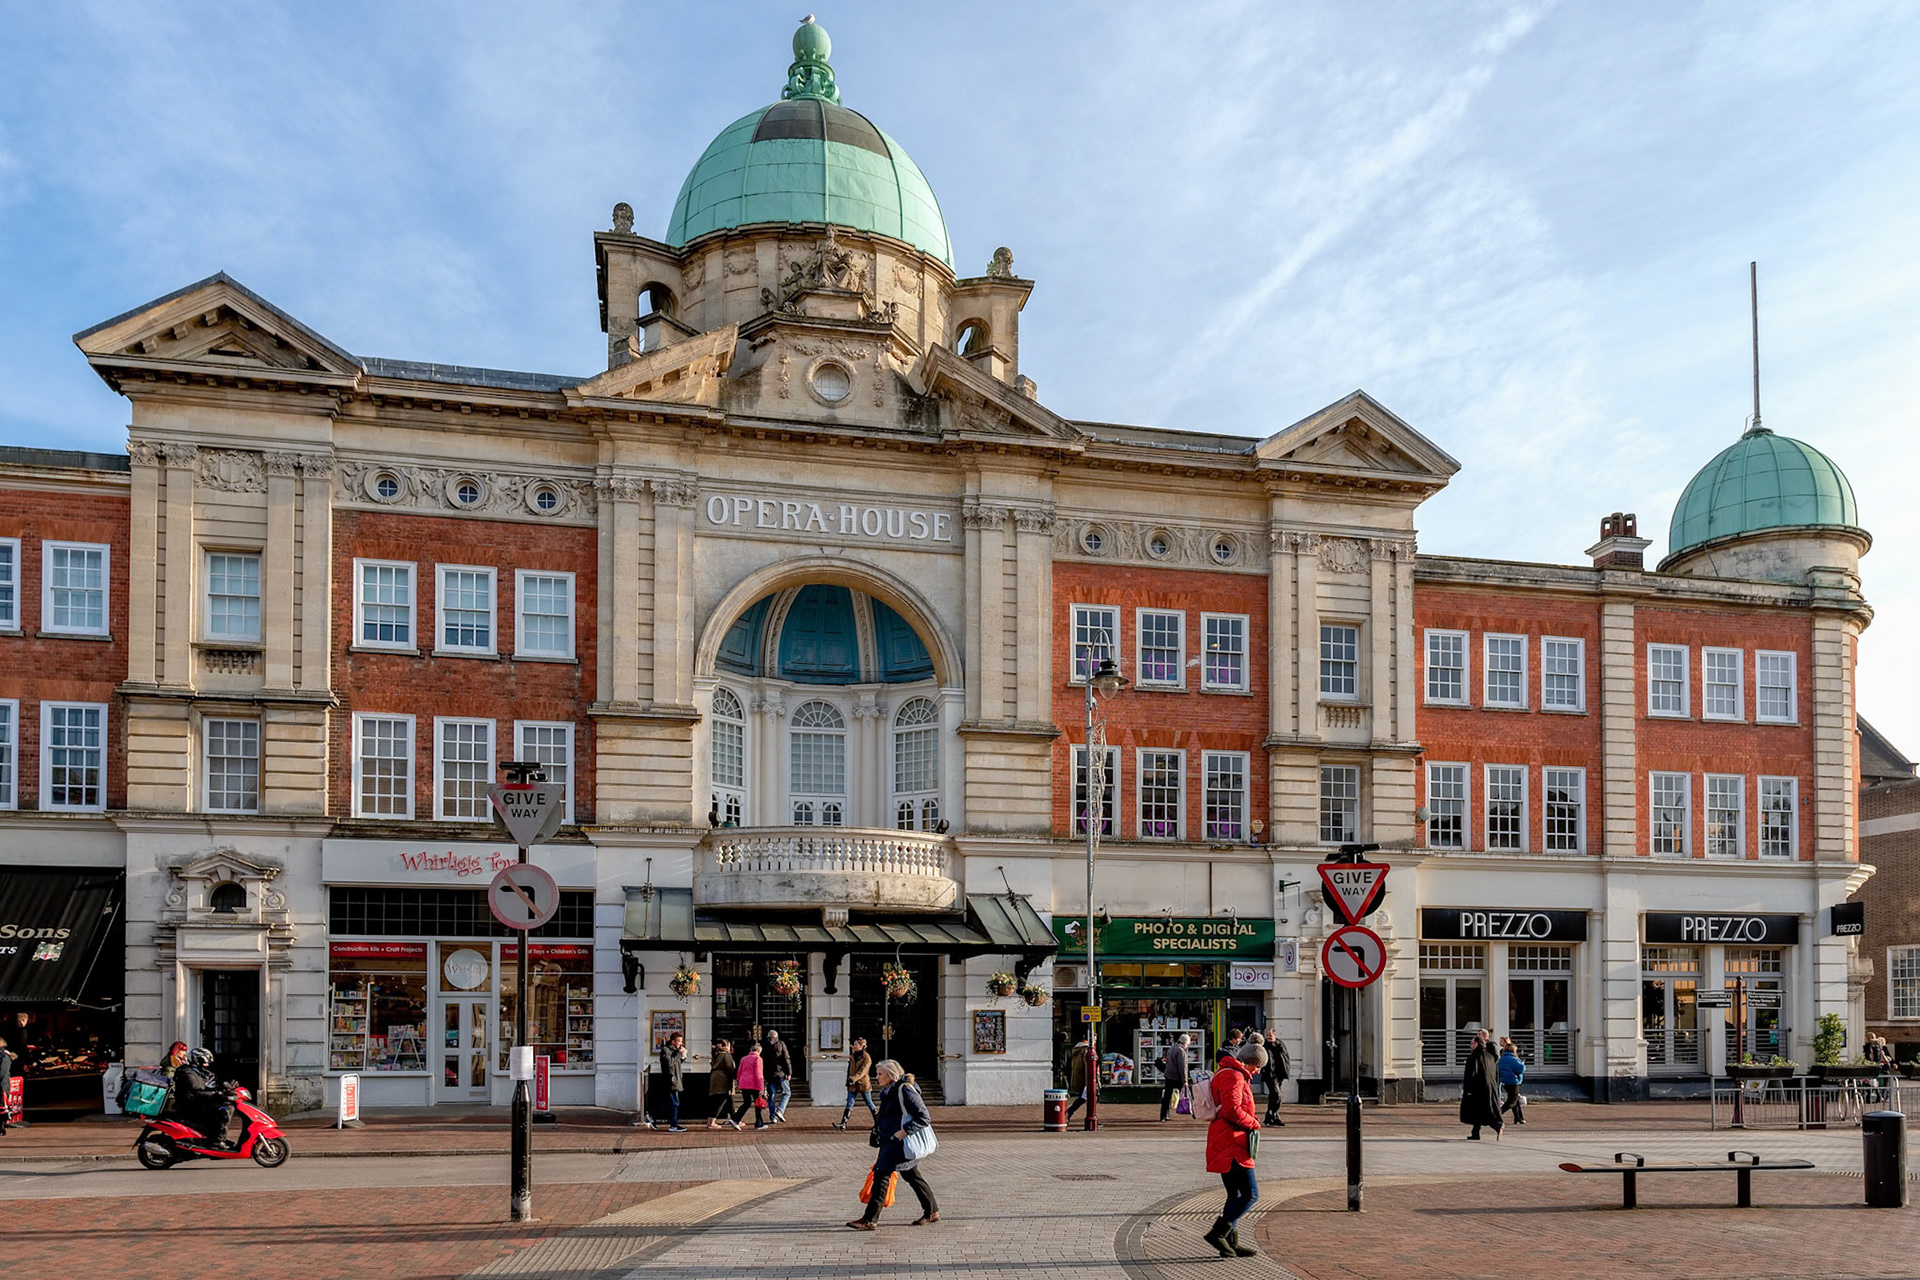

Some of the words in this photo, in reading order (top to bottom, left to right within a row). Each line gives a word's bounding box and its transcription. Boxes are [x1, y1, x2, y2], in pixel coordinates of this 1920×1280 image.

[706, 495, 830, 533] OPERA
[837, 505, 952, 542] HOUSE
[503, 792, 546, 805] GIVE
[511, 808, 539, 818] WAY
[399, 851, 483, 877] Whirligig
[1333, 871, 1373, 884] GIVE
[1341, 887, 1367, 896] WAY
[0, 923, 71, 940] Sons
[1133, 922, 1184, 935] PHOTO
[1187, 923, 1197, 935] &
[1202, 923, 1256, 936] DIGITAL
[1460, 911, 1552, 939] PREZZO
[1680, 916, 1767, 942] PREZZO
[1836, 923, 1862, 934] PREZZO
[401, 946, 423, 954] Projects
[1153, 938, 1237, 950] SPECIALISTS
